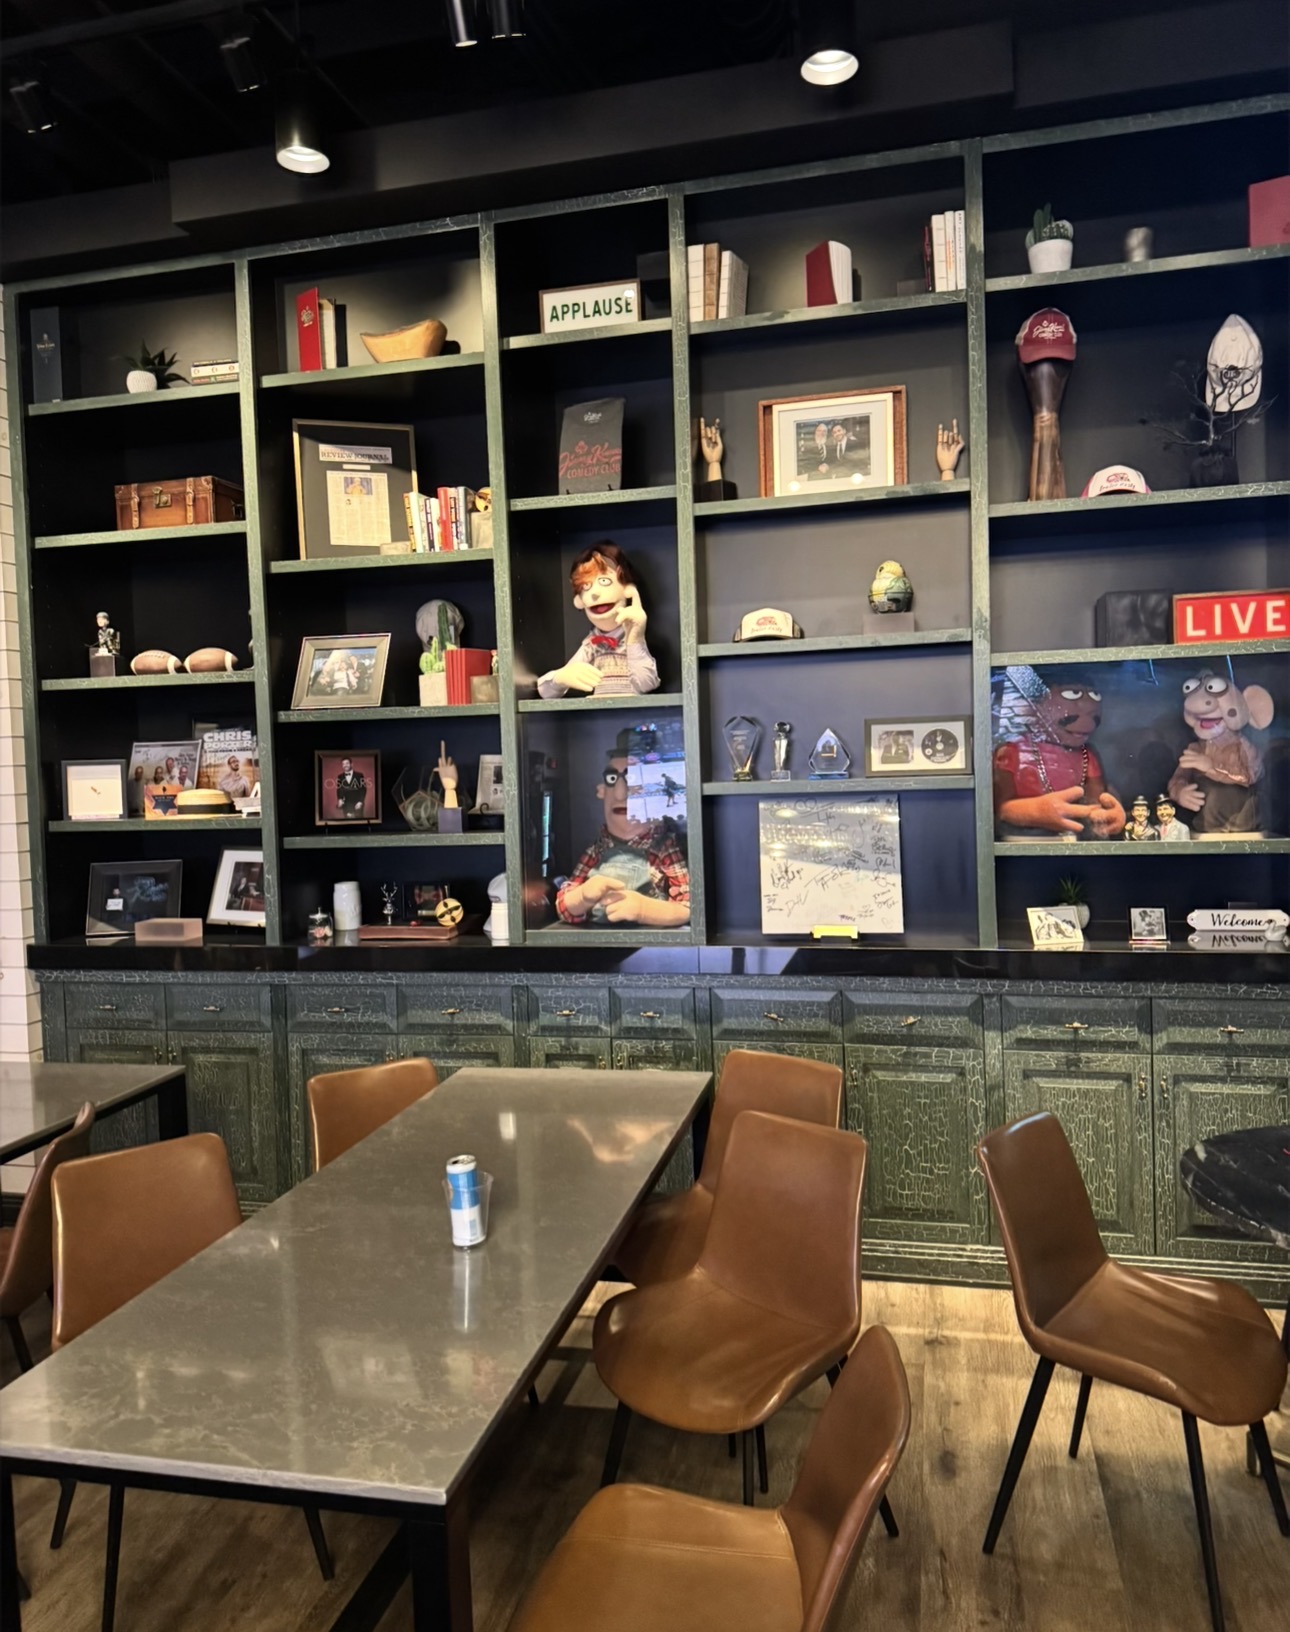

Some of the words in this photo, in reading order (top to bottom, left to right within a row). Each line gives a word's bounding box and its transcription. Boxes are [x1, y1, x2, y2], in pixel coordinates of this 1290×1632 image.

[550, 296, 633, 323] APPLAUSE
[321, 450, 354, 459] REVIEW
[1186, 600, 1286, 637] LIVE
[203, 730, 252, 742] CHRIS
[324, 777, 373, 790] OSCARS
[1211, 912, 1266, 927] Welcome
